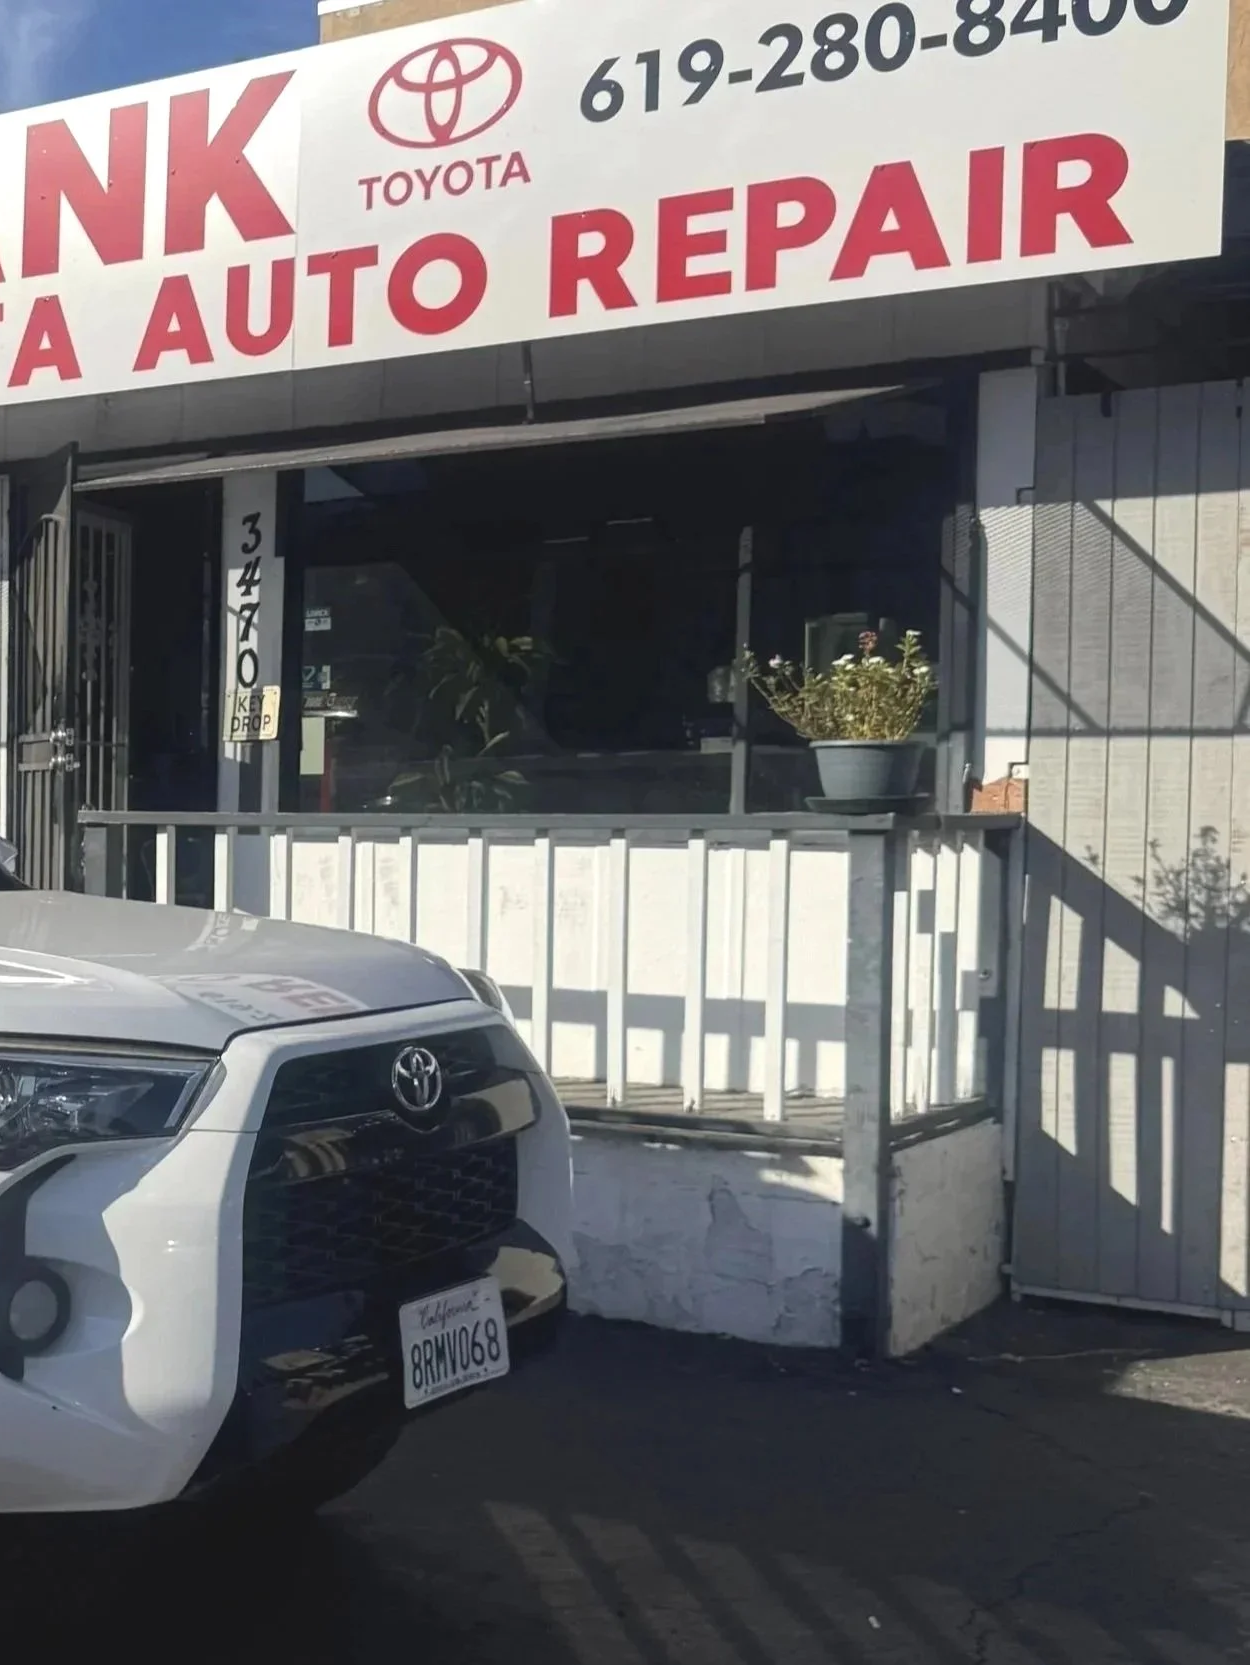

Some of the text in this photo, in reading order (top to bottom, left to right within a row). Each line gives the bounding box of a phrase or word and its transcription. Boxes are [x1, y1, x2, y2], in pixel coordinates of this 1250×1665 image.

[358, 151, 532, 210] TOYOTA
[131, 233, 489, 372] AUTO
[549, 132, 1134, 318] REPAIR
[236, 511, 263, 689] 3470
[231, 714, 272, 733] DROP
[238, 695, 265, 713] KEY
[419, 1297, 480, 1330] California
[411, 1317, 500, 1389] 8RMV068
